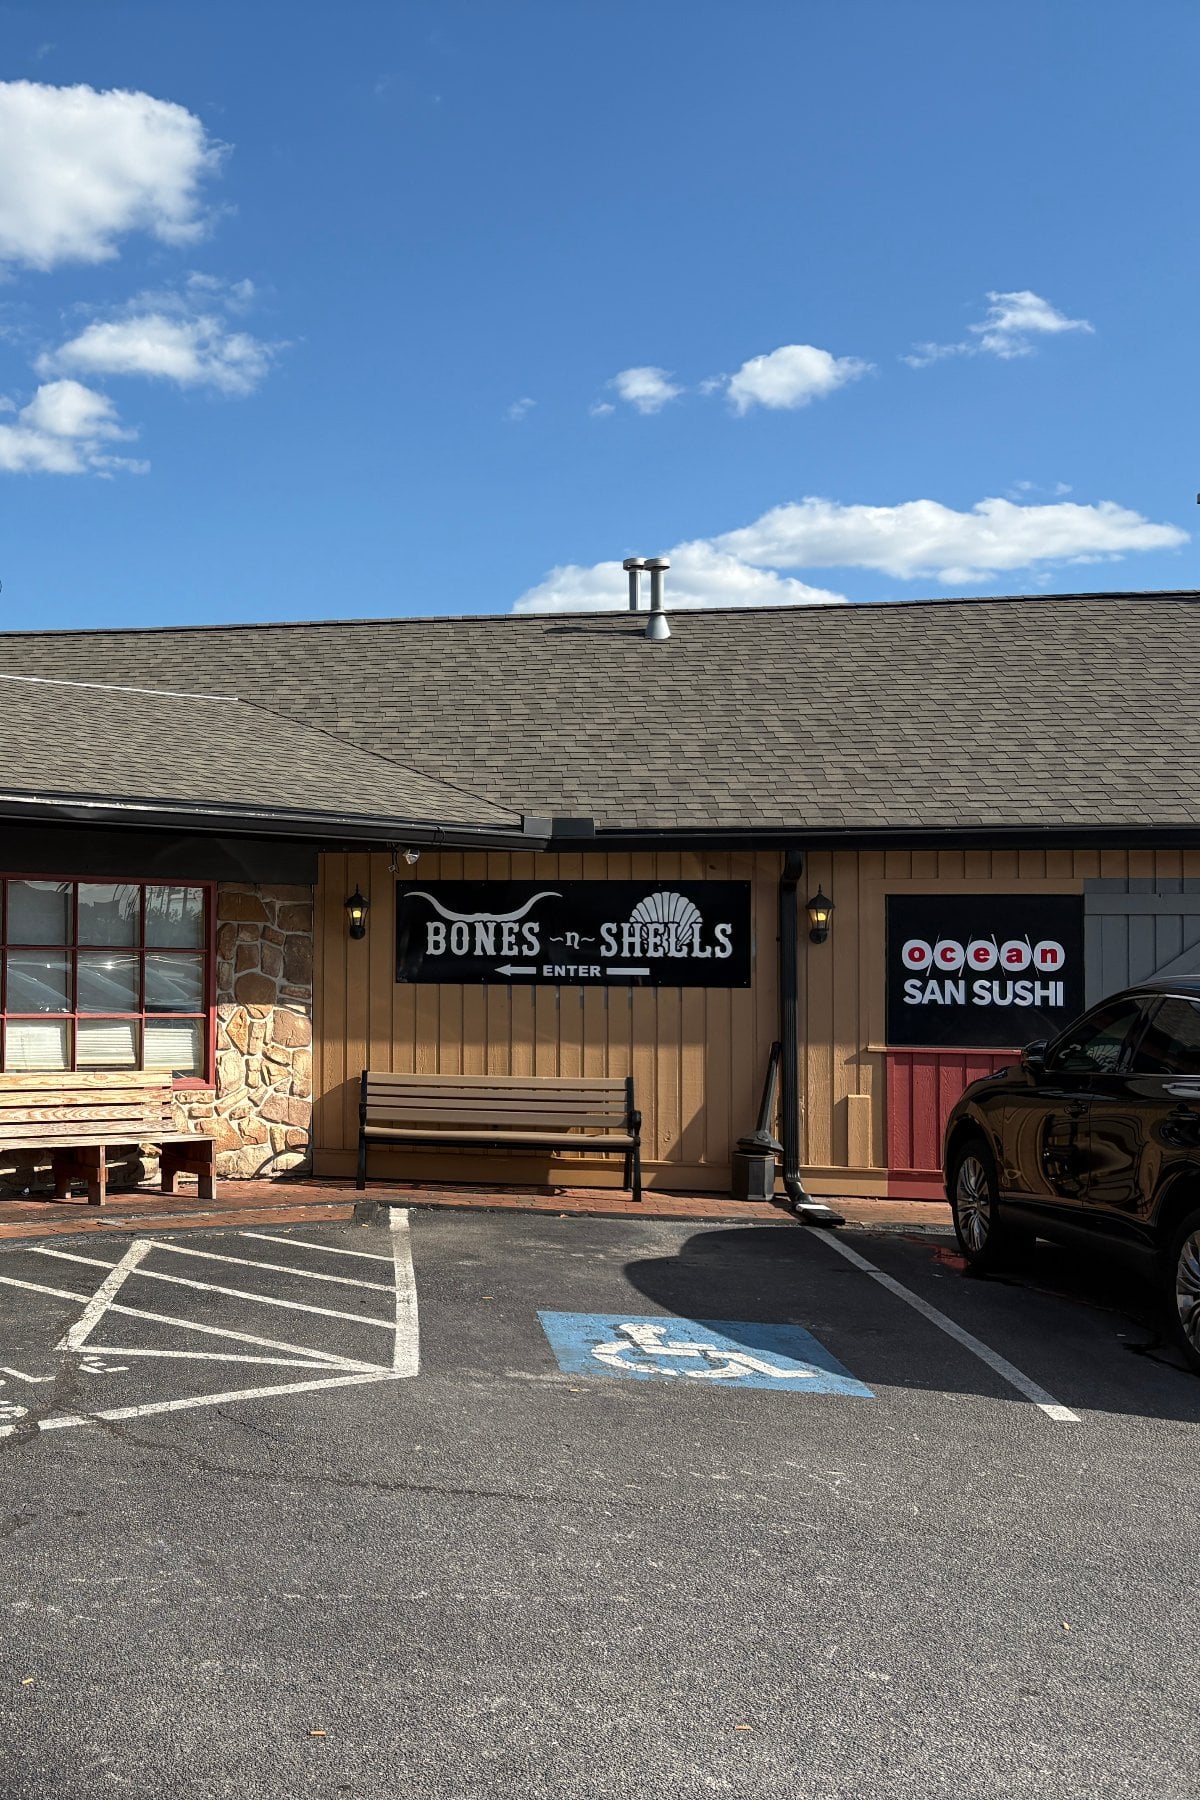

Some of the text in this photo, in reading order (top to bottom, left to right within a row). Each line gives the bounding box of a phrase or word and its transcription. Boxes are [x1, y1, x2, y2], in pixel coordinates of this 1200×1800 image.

[425, 920, 541, 956] BONES
[599, 922, 733, 959] SHELLS
[542, 965, 601, 978] ENTER
[903, 978, 1064, 1007] SAN SUSHI
